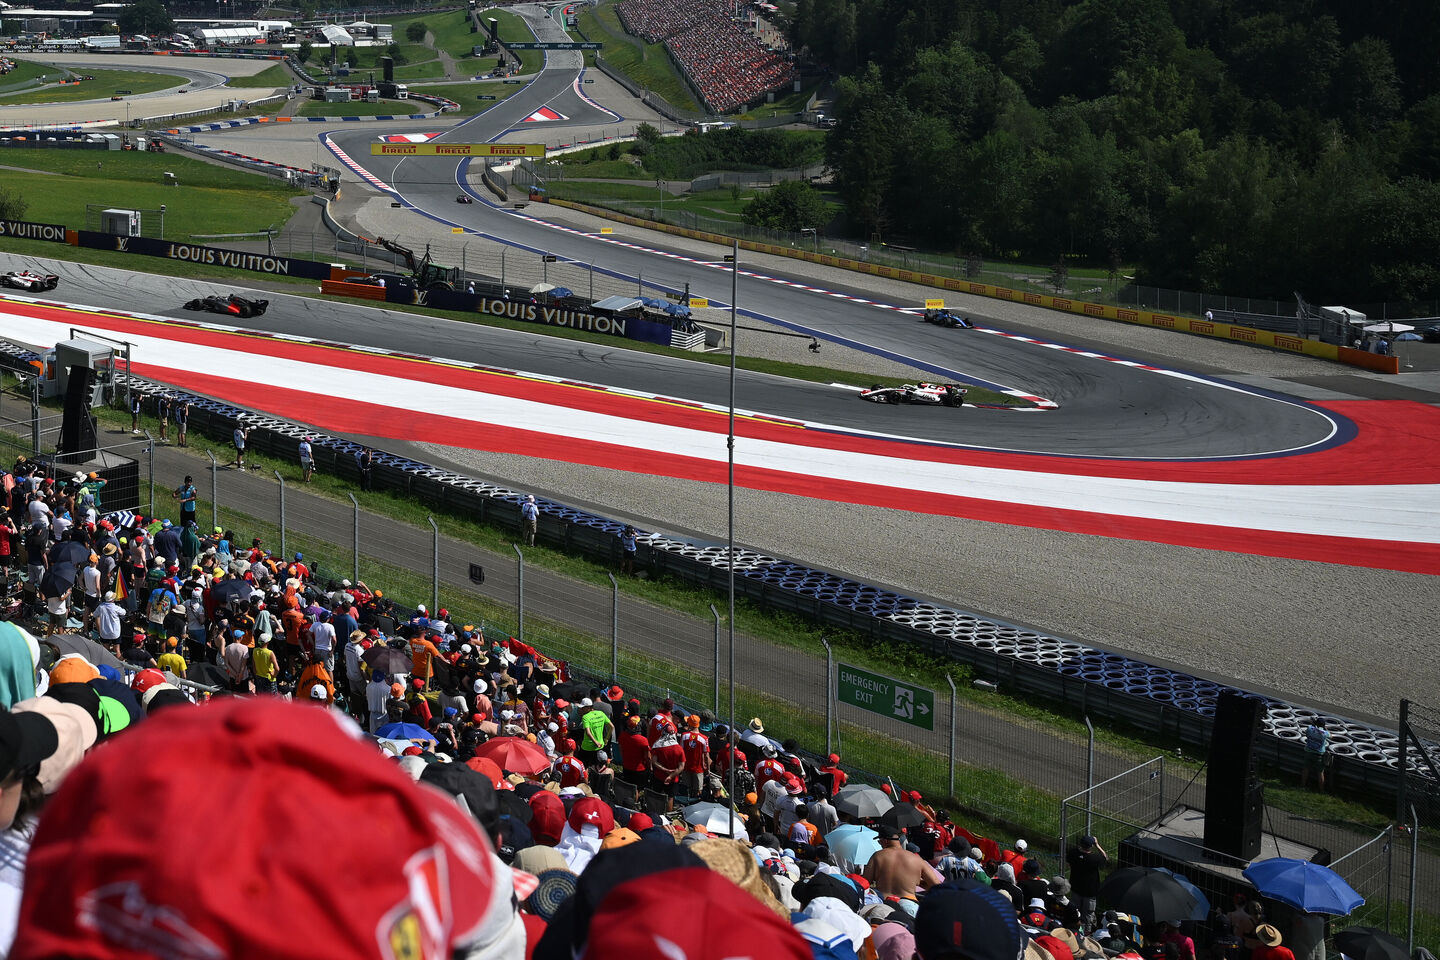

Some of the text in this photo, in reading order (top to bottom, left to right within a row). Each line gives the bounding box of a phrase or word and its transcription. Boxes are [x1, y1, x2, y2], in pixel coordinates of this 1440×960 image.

[381, 145, 417, 154] PIRELLI
[435, 145, 471, 154] PIRELLI
[490, 146, 526, 155] PIRELLI
[9, 220, 66, 241] VUITTON
[171, 244, 289, 275] LOUIS VUITTON
[481, 297, 626, 337] LOUIS VUITTON
[1084, 304, 1104, 316] PIRELLI
[1117, 309, 1139, 322] PIRELLI
[1152, 315, 1175, 328] PIRELLI
[1189, 320, 1214, 334] PIRELLI
[1230, 327, 1257, 342] PIRELLI
[1274, 336, 1303, 352] PIRELLI
[841, 671, 889, 695] EMERGENCY
[855, 690, 874, 705] EXIT
